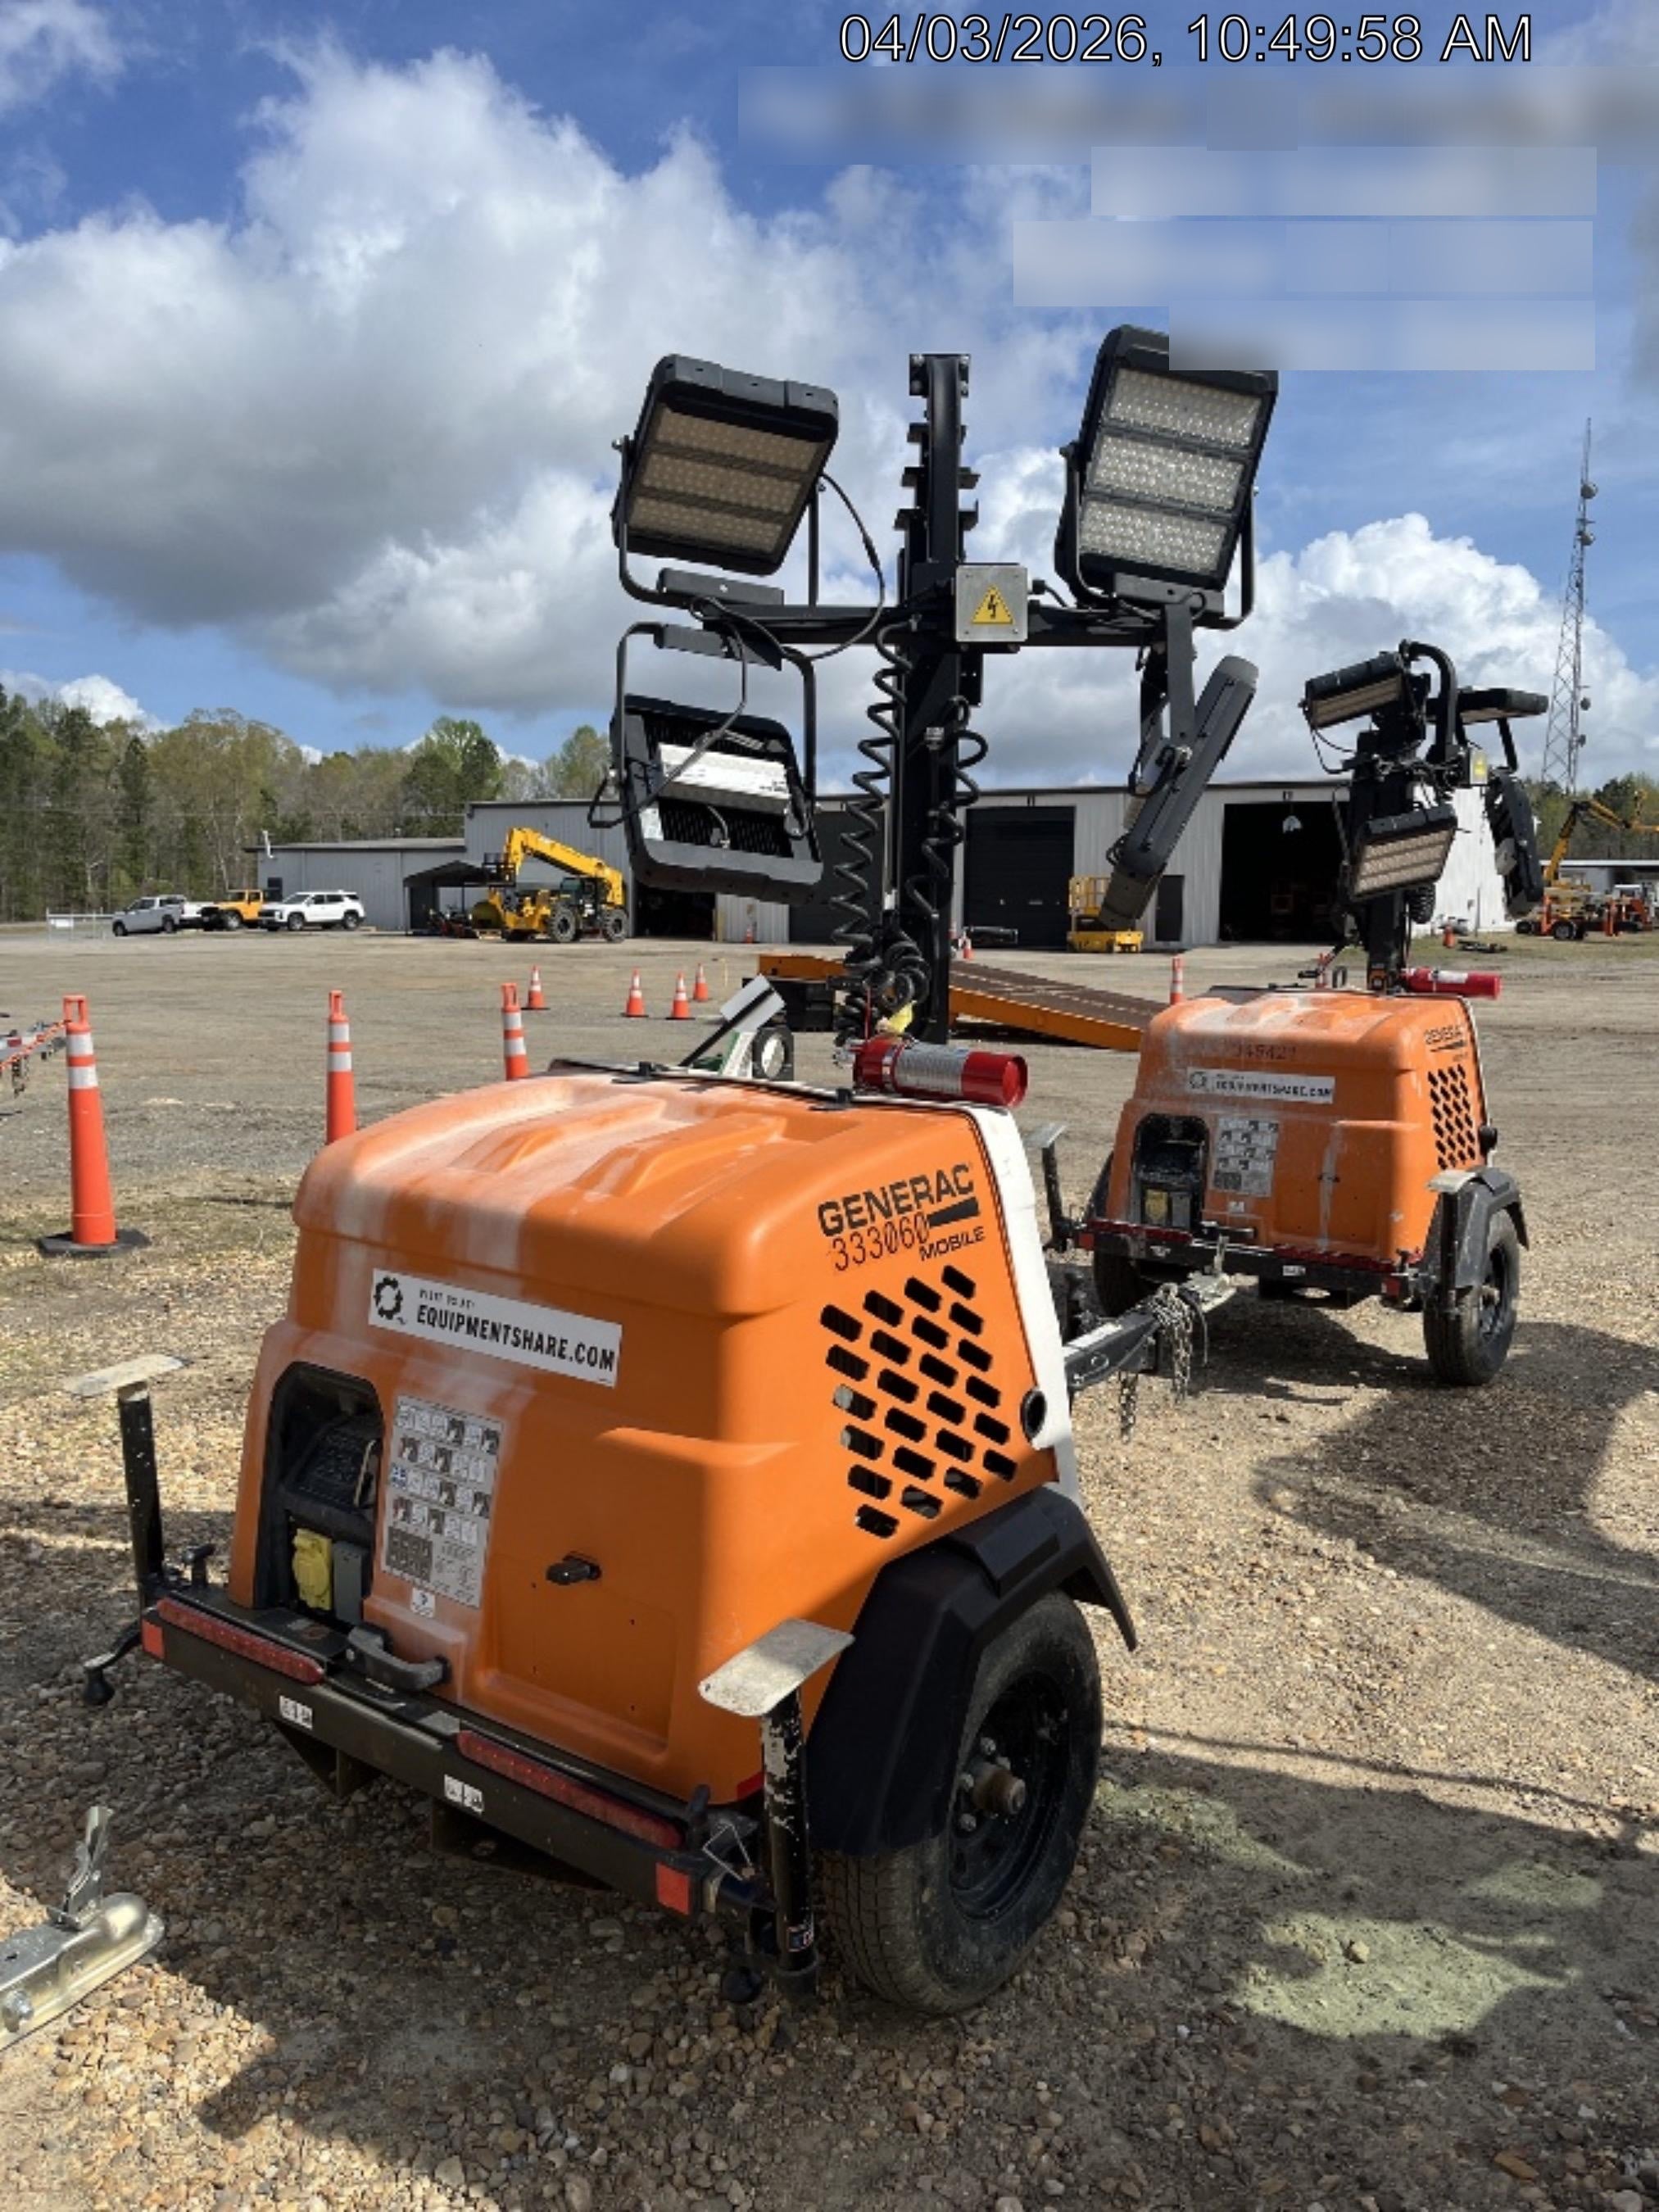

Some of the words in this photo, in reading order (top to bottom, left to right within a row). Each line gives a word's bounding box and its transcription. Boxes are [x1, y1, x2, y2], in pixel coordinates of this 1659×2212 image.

[818, 1164, 974, 1236] GENERAC
[832, 1212, 930, 1271] 333060
[919, 1226, 985, 1262] MOBILE
[417, 1304, 614, 1372] EQUIPMENTSHARE.COM
